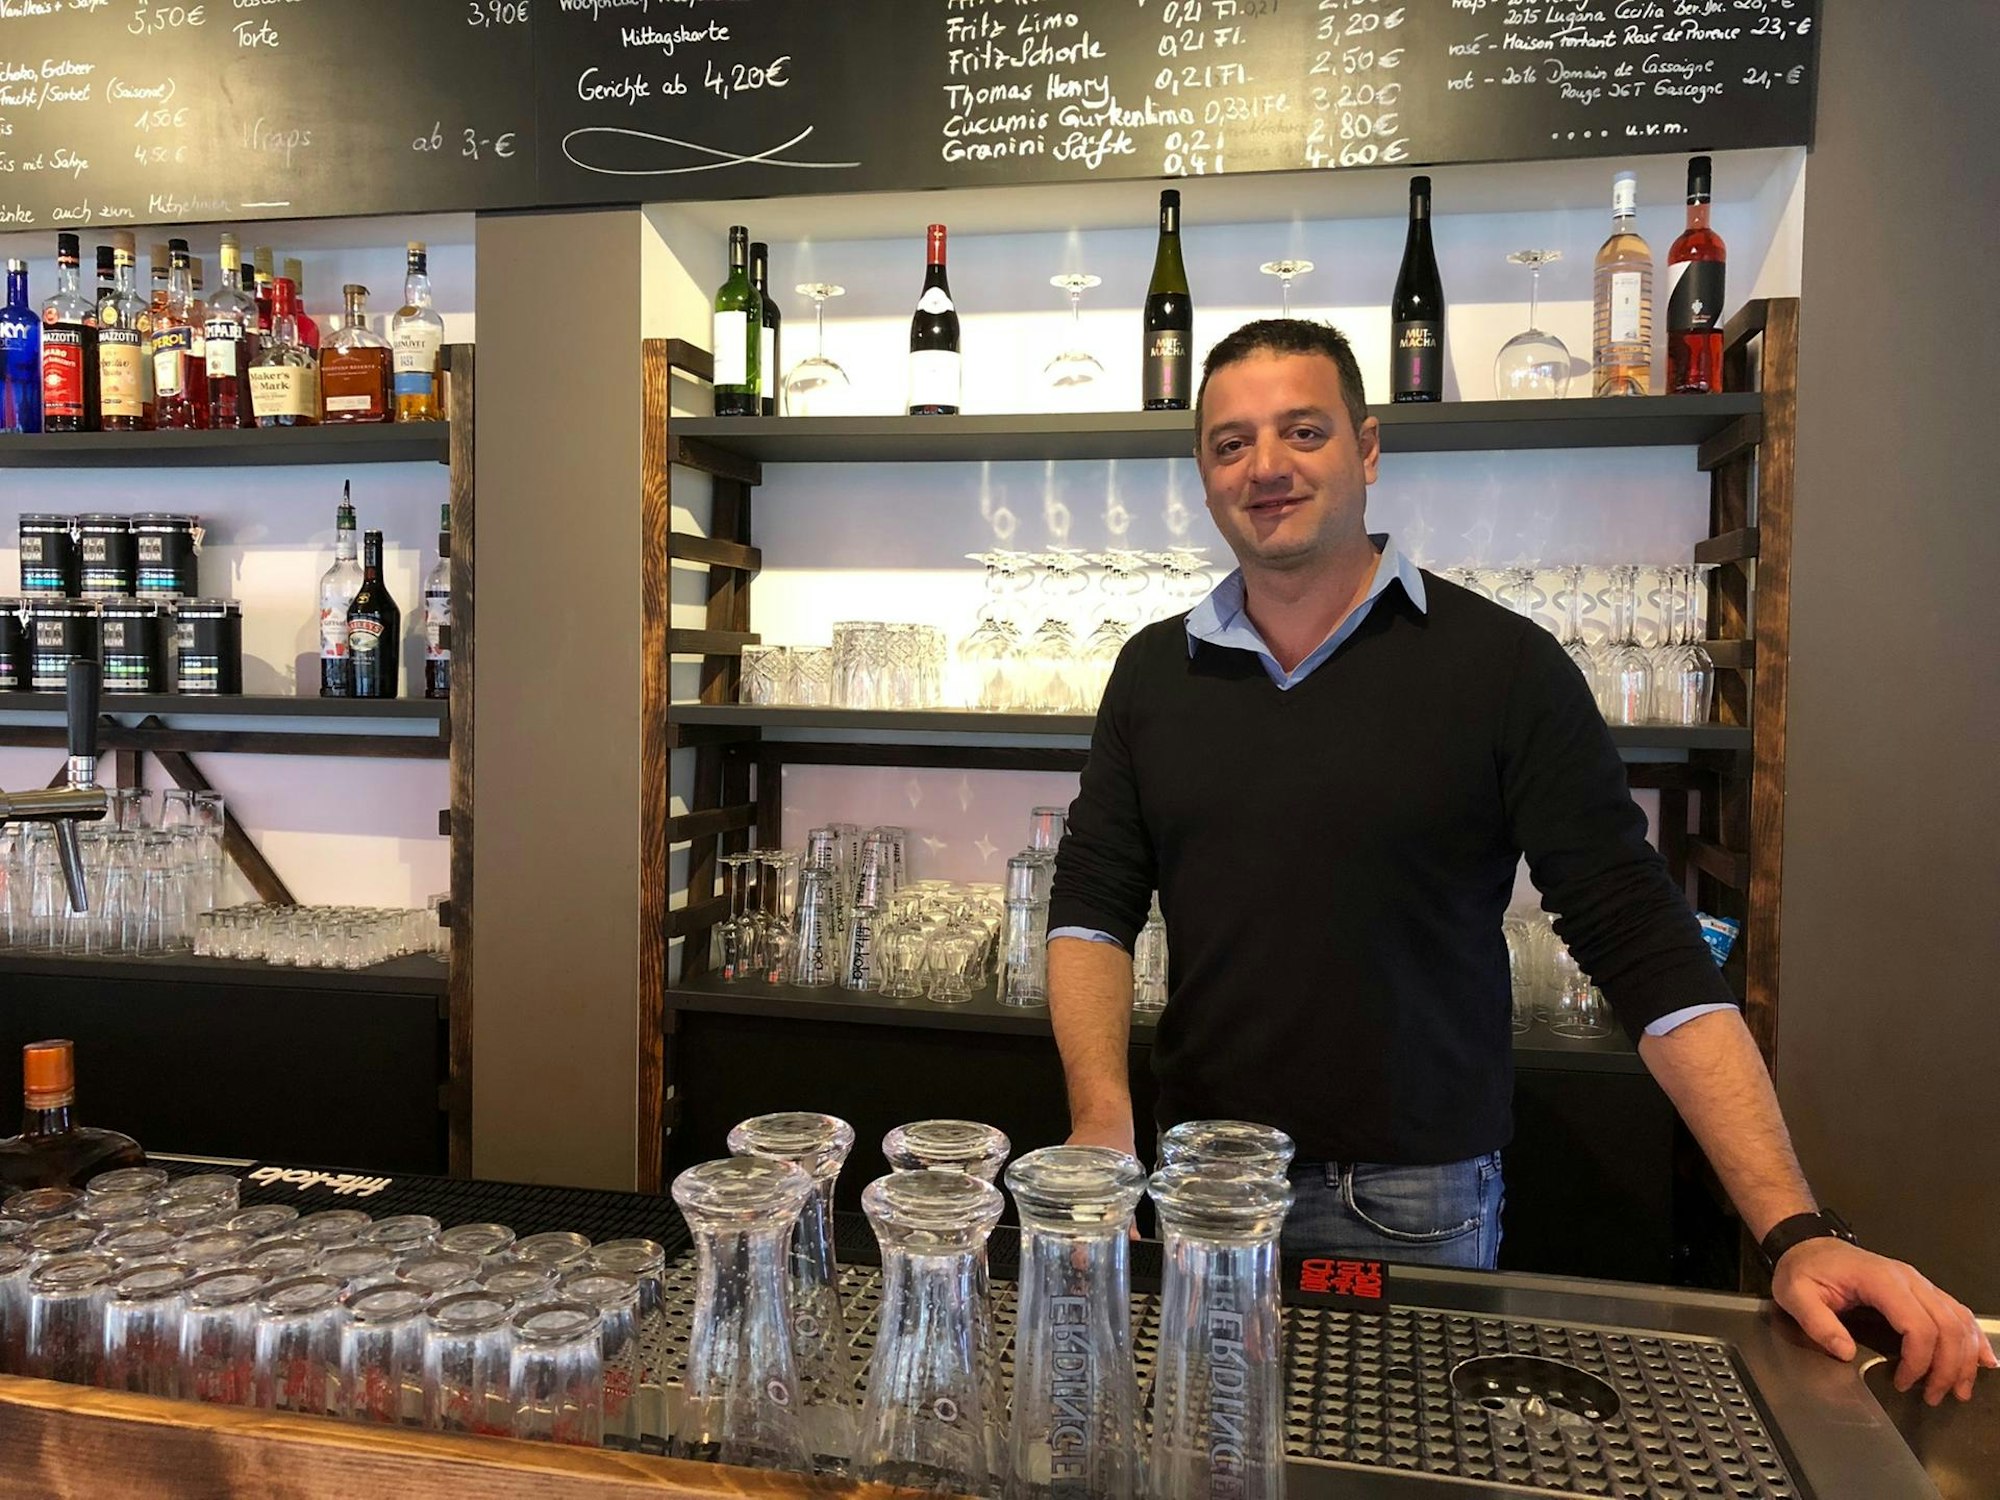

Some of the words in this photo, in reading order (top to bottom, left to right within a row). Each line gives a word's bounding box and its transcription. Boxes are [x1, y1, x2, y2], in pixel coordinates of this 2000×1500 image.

[128, 6, 206, 34] 5,50€
[467, 0, 529, 28] 3,90€
[946, 12, 1006, 42] Fritz
[1017, 13, 1079, 36] Limo
[1503, 9, 1541, 24] 2015
[1545, 6, 1606, 32] Lugana
[1614, 0, 1664, 19] Cecilia
[232, 19, 279, 48] Torte
[621, 20, 730, 56] Mittagskarte
[1503, 32, 1554, 50] Maison
[1623, 25, 1664, 45] Rosé
[0, 62, 38, 82] choko,
[577, 67, 650, 105] Gerichte
[662, 74, 687, 95] ab
[704, 56, 791, 100] 4,20€
[1448, 71, 1474, 90] rot
[1501, 65, 1537, 85] 2016
[1614, 61, 1633, 77] de
[943, 83, 1033, 117] Thomas
[1047, 73, 1109, 109] Henry
[1560, 83, 1600, 105] Rouge
[1654, 79, 1723, 104] Gascogne
[412, 121, 443, 151] ab
[943, 109, 1049, 137] Cucumis
[942, 136, 1045, 162] Granini
[23, 158, 44, 171] mit
[50, 149, 89, 178] Sahne
[53, 200, 91, 222] auch
[99, 206, 135, 218] zum
[1400, 338, 1436, 348] MACHA
[1405, 328, 1432, 338] MUT-
[1150, 347, 1186, 357] MACHA
[250, 372, 290, 381] Maker's
[260, 382, 290, 391] Mark
